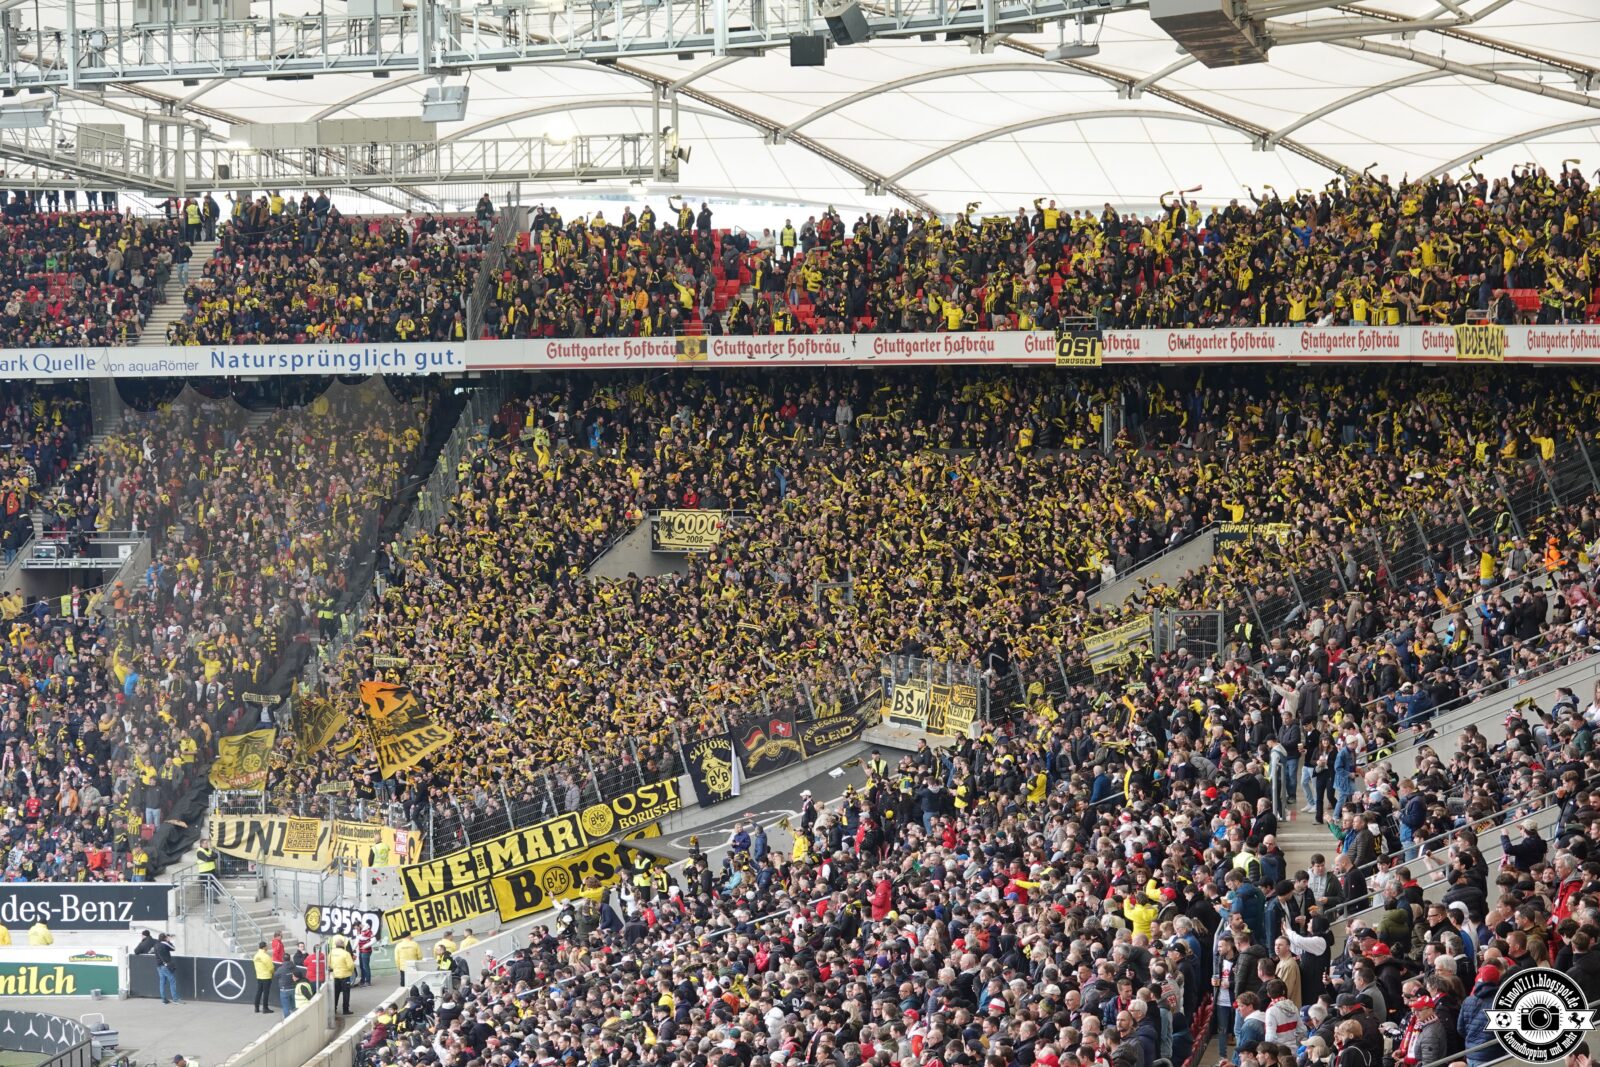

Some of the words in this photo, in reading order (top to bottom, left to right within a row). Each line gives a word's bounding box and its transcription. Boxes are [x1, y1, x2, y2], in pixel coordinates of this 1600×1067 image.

[546, 340, 621, 361] Stuttgarter
[713, 338, 785, 359] Stuttgarter
[787, 337, 841, 357] Hofbräu
[873, 336, 942, 358] Stuttgarter
[943, 335, 995, 356] Hofbräu
[1101, 333, 1141, 352] ofbräu
[1167, 332, 1229, 354] Stuttgarter
[1230, 331, 1275, 352] Hofbräu
[1301, 331, 1356, 353] Stuttgarter
[1357, 330, 1400, 352] Hofbräu
[1422, 329, 1455, 354] Stuttga
[1527, 329, 1569, 354] Stuttgarter
[33, 353, 96, 373] Quelle
[103, 362, 125, 372] von
[128, 359, 199, 377] aquaRömer
[211, 348, 406, 371] Natursprünglich
[414, 350, 463, 371] gut.
[673, 513, 720, 536] CODO
[1219, 522, 1269, 535] SUPPORERS
[686, 535, 704, 544] 2008
[814, 725, 853, 747] ELEND
[689, 737, 732, 764] SAILORS
[709, 769, 730, 786] BVB
[612, 777, 678, 816] OST
[590, 811, 606, 826] BVB
[216, 819, 330, 862] UNIY
[406, 818, 579, 901] WEIMAR
[546, 868, 567, 889] BVB
[384, 882, 495, 942] MEERANE
